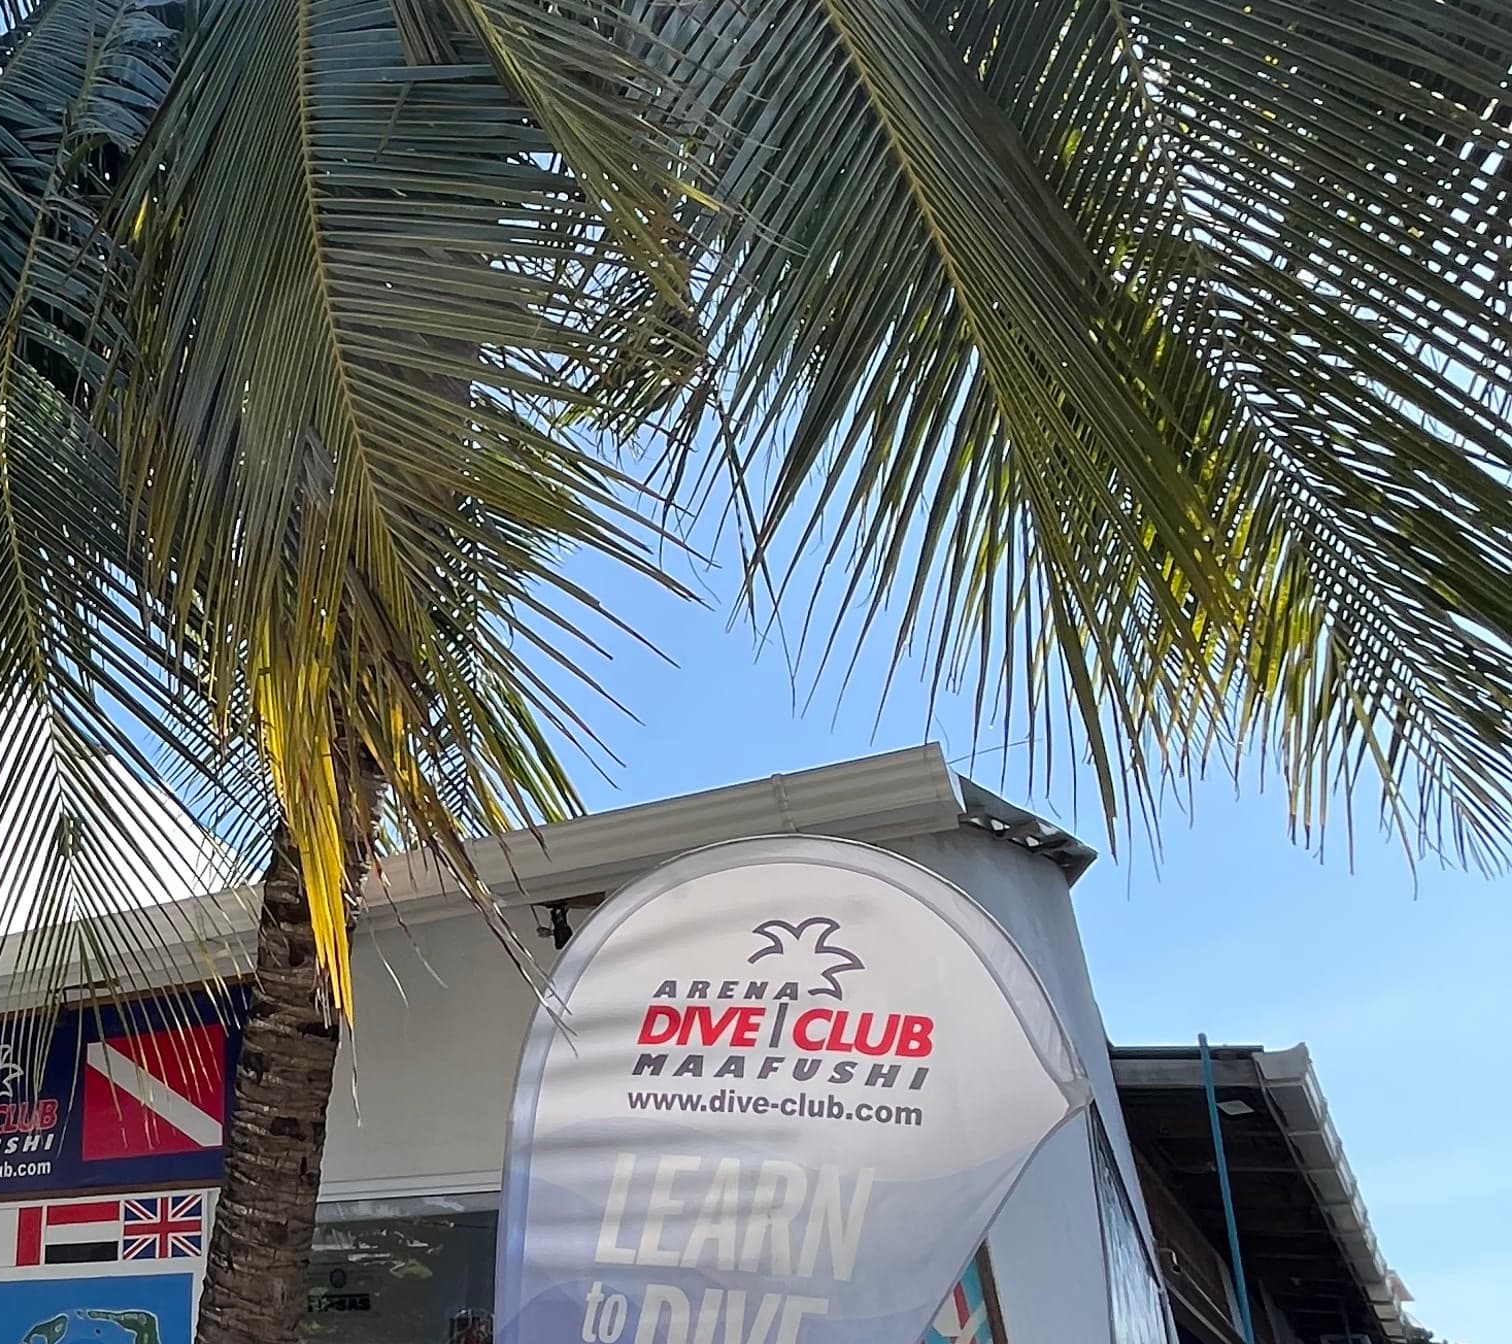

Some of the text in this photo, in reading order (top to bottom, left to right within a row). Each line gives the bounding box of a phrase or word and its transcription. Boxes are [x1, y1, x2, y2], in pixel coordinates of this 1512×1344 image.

[653, 979, 800, 1001] ARENA
[636, 1005, 935, 1058] DIVE CLUB
[630, 1053, 931, 1091] MAAFUSHI
[627, 1088, 924, 1127] www.dive-club.com
[594, 1152, 876, 1282] LEARN
[581, 1281, 628, 1344] to
